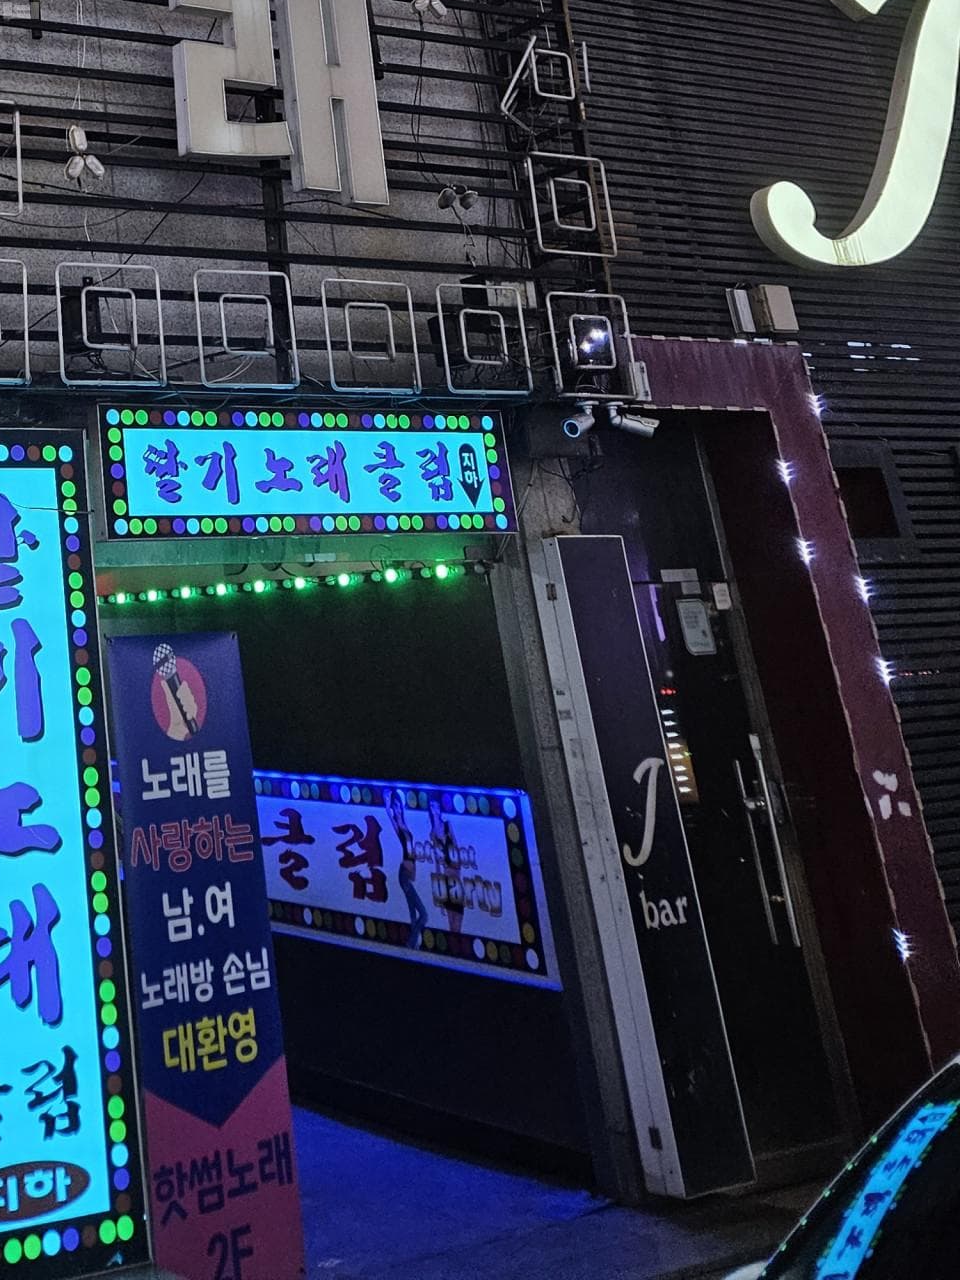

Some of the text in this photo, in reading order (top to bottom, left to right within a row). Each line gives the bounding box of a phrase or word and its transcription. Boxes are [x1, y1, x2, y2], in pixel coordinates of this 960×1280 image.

[462, 452, 479, 489] 지하
[141, 748, 233, 802] 노래를
[622, 756, 666, 868] J
[130, 813, 256, 873] 사랑하는
[260, 807, 389, 904] 클럽
[162, 881, 236, 944] 남.여
[639, 890, 690, 930] bar
[141, 946, 272, 1011] 노래방 손님
[162, 1007, 259, 1074] 대환영
[206, 1223, 255, 1280] 2F
